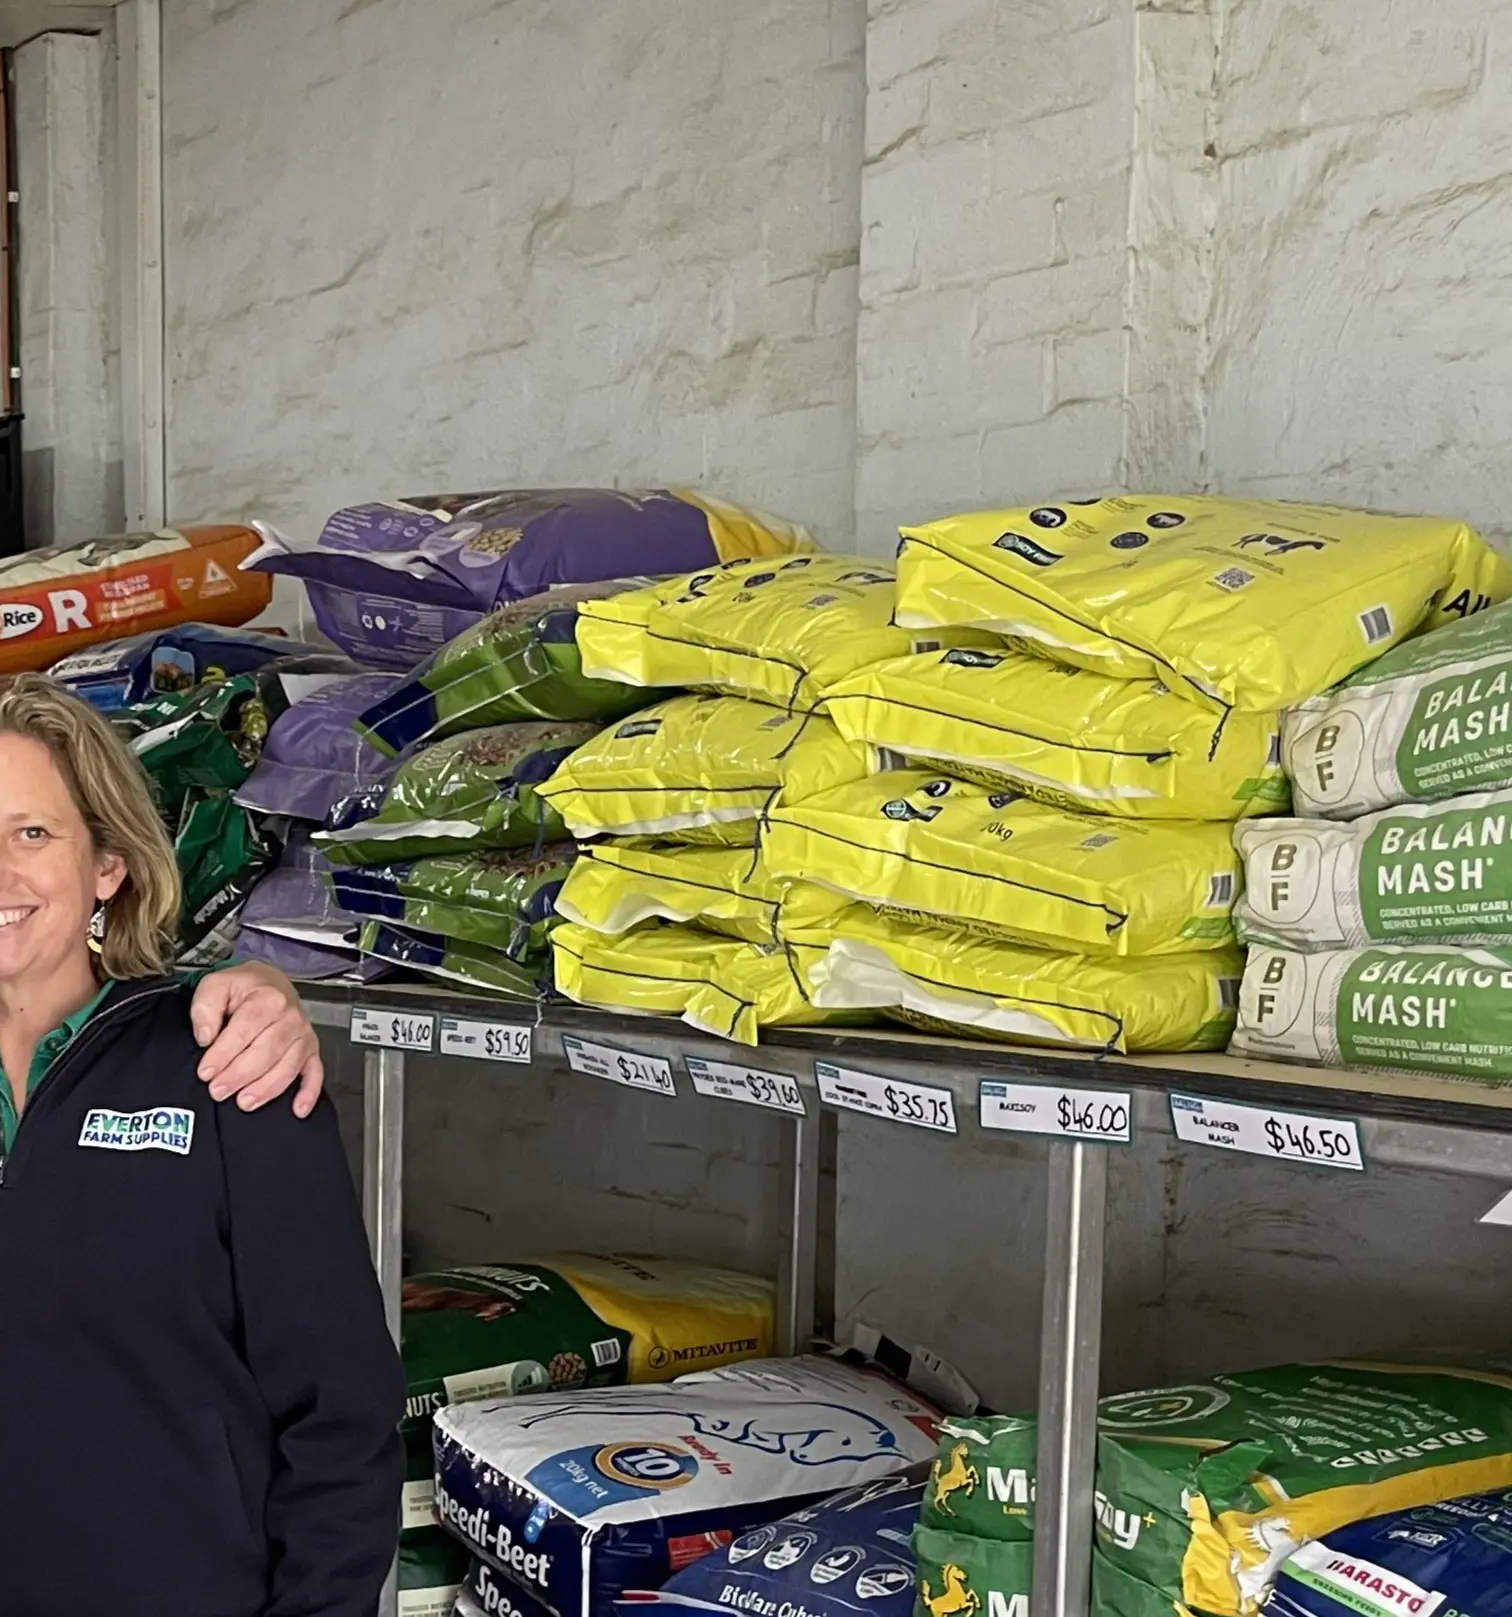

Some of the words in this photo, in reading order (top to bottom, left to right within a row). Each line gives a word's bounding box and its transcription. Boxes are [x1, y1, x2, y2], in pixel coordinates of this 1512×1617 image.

[47, 589, 93, 634] R
[1315, 726, 1340, 754] B
[1412, 702, 1510, 756] MASH
[1316, 761, 1334, 792] F
[1271, 843, 1298, 871] B
[1378, 857, 1484, 896] MASH
[1271, 882, 1289, 911] F
[1380, 904, 1455, 919] CONCENTRATED,
[1457, 902, 1479, 914] LOW
[1481, 900, 1508, 912] CARB
[1263, 956, 1287, 984] B
[1257, 994, 1276, 1023] F
[1352, 992, 1447, 1028] MASH
[391, 1017, 430, 1043] $46.00
[485, 1027, 529, 1056] $59.50
[1421, 1040, 1440, 1050] LOW
[1442, 1042, 1468, 1053] CARB
[884, 1084, 949, 1127] $35.75
[999, 1102, 1037, 1113] MAXISOY
[1058, 1094, 1128, 1132] $46.00
[88, 1110, 190, 1135] EVERTON
[1192, 1115, 1240, 1133] BALANCER
[84, 1130, 123, 1146] FARM
[124, 1131, 188, 1149] SUPPLIES
[1208, 1133, 1236, 1145] MASH
[1264, 1116, 1352, 1158] $46.50
[672, 1337, 758, 1363] MITAVITE
[623, 1448, 681, 1476] 10
[559, 1459, 588, 1484] 20kg
[585, 1480, 610, 1499] net
